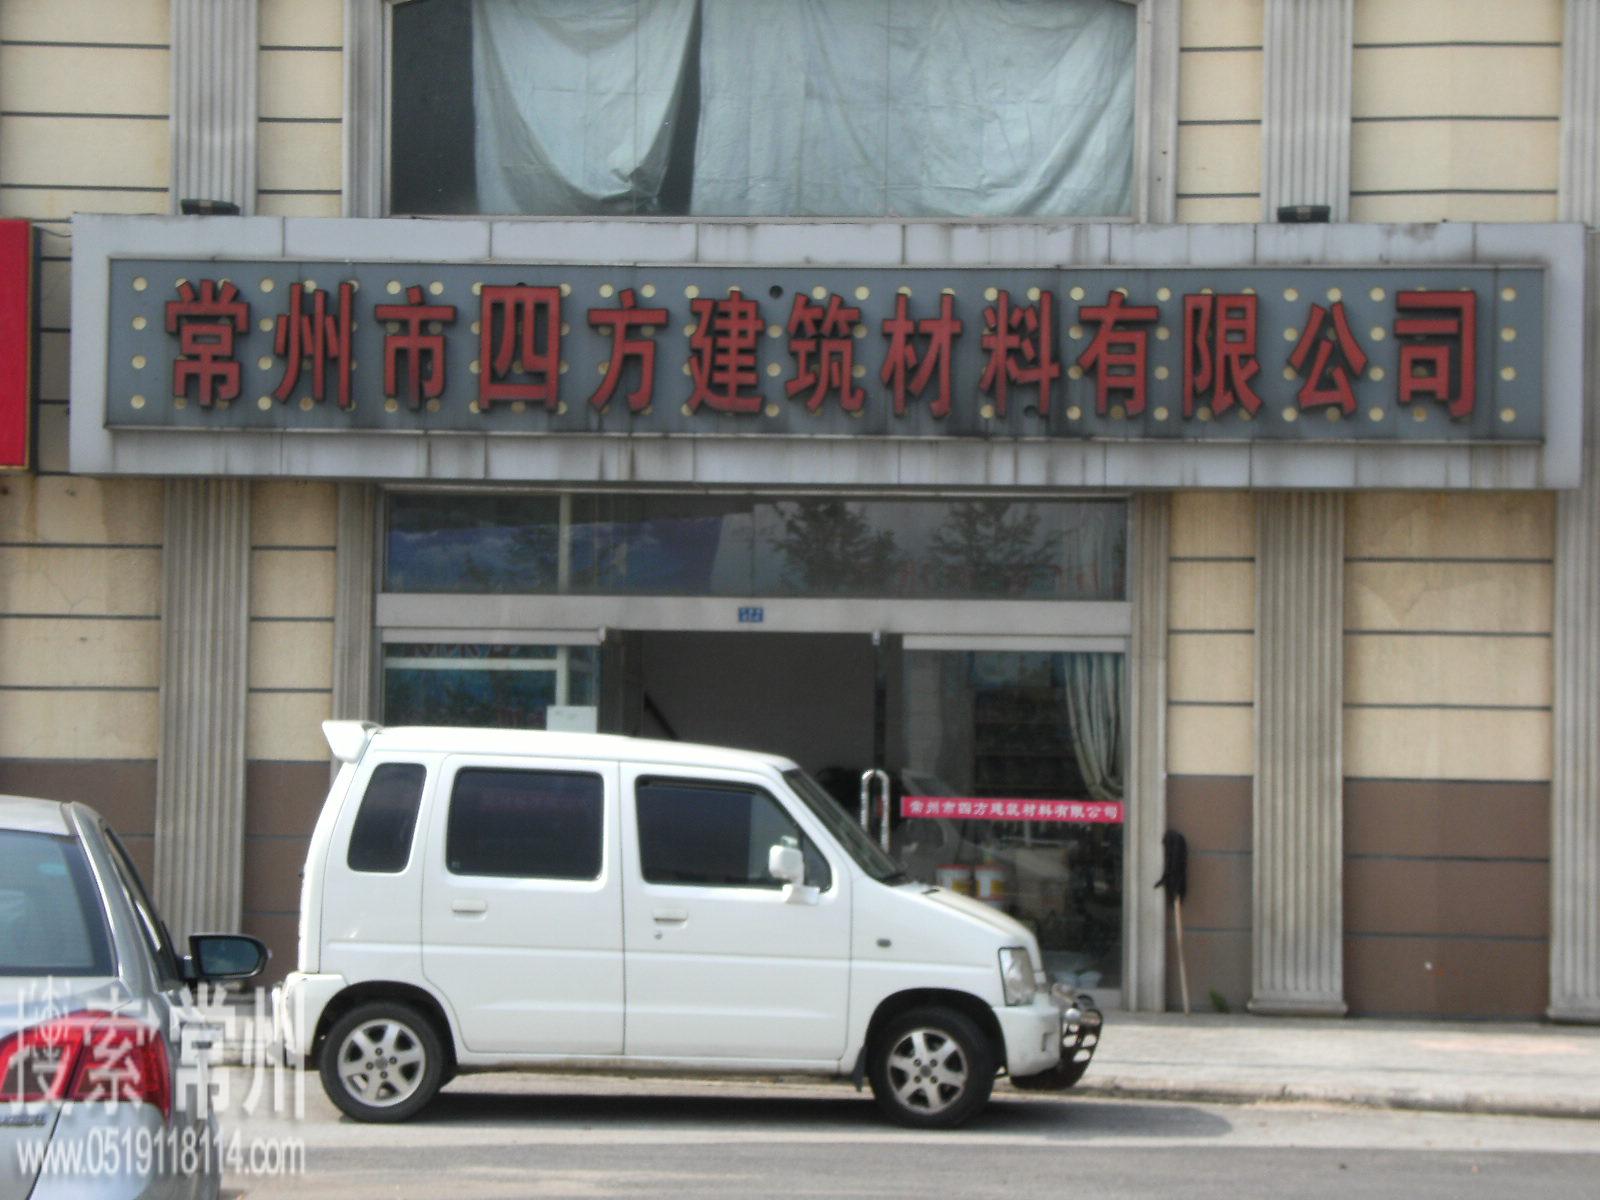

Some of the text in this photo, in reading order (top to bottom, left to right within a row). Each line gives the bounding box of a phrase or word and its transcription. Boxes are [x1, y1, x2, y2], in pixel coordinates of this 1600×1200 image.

[164, 279, 1477, 419] 常州市四方建筑材料有限公司
